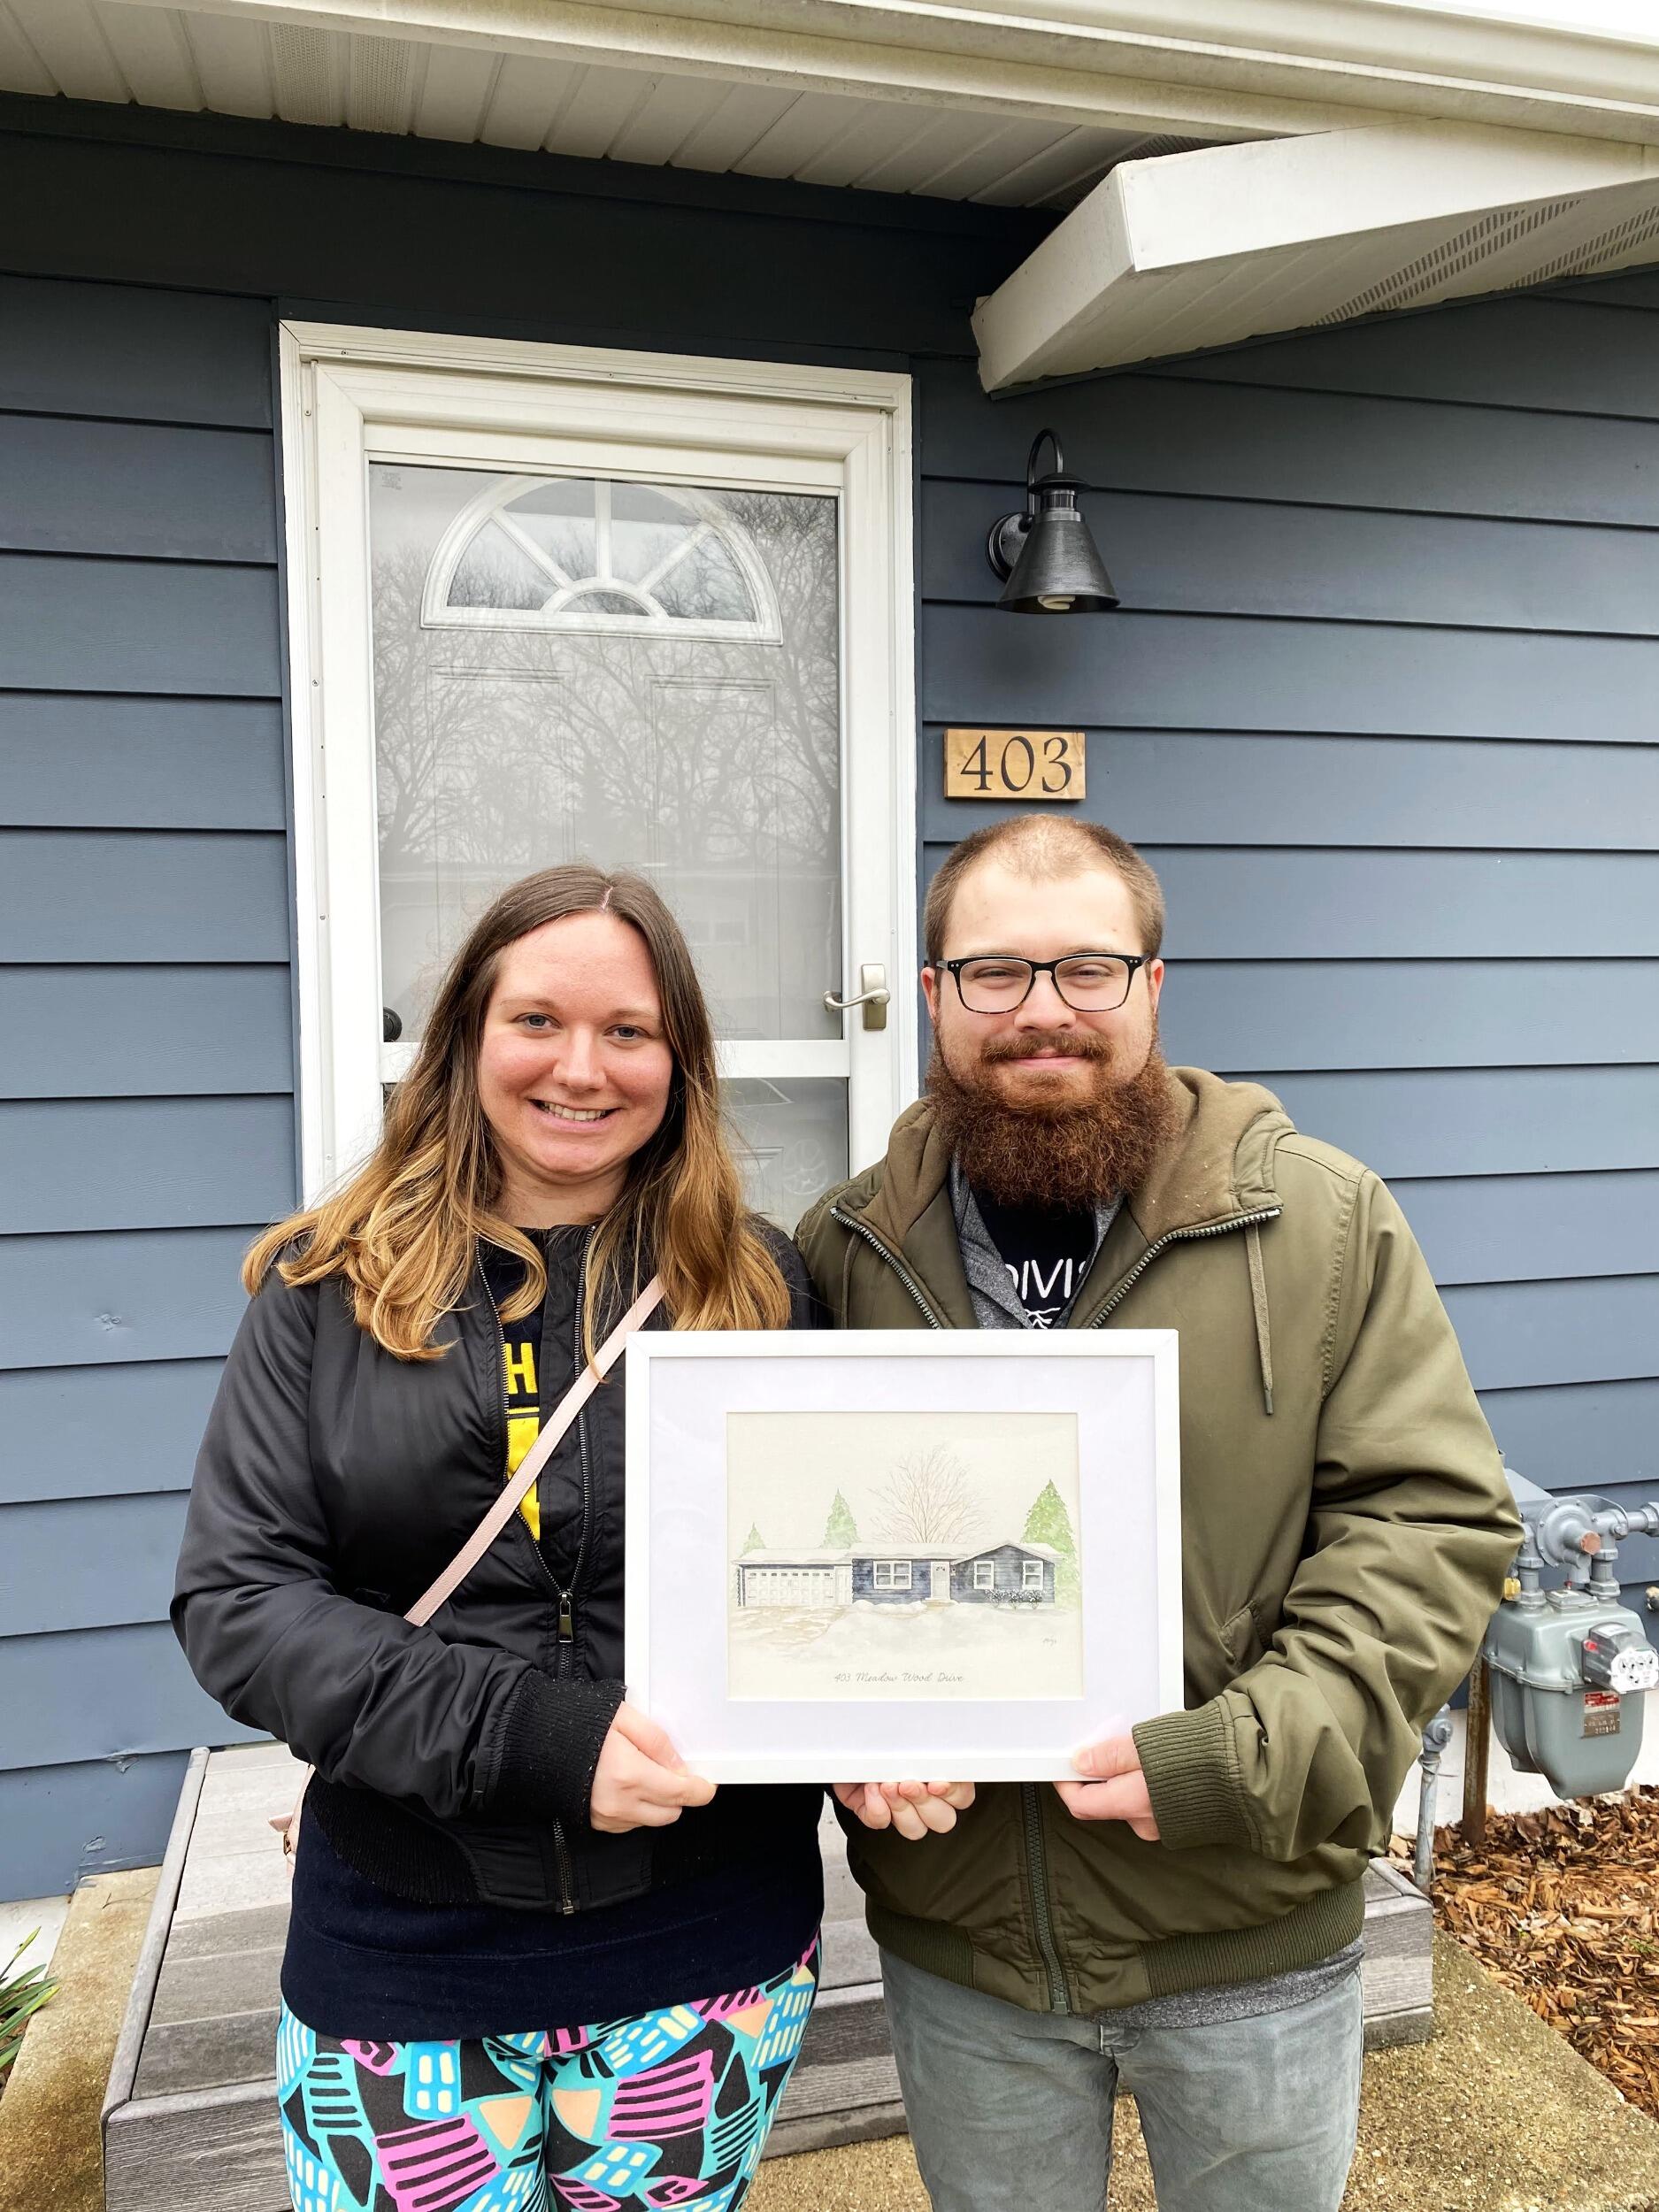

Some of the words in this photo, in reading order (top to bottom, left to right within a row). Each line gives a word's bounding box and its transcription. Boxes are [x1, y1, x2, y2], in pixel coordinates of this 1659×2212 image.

[960, 735, 1072, 793] 403
[1005, 1258, 1086, 1301] IVI
[834, 1672, 851, 1683] 403
[856, 1671, 897, 1683] Meadow
[902, 1672, 933, 1683] Wood
[937, 1671, 964, 1683] Drive
